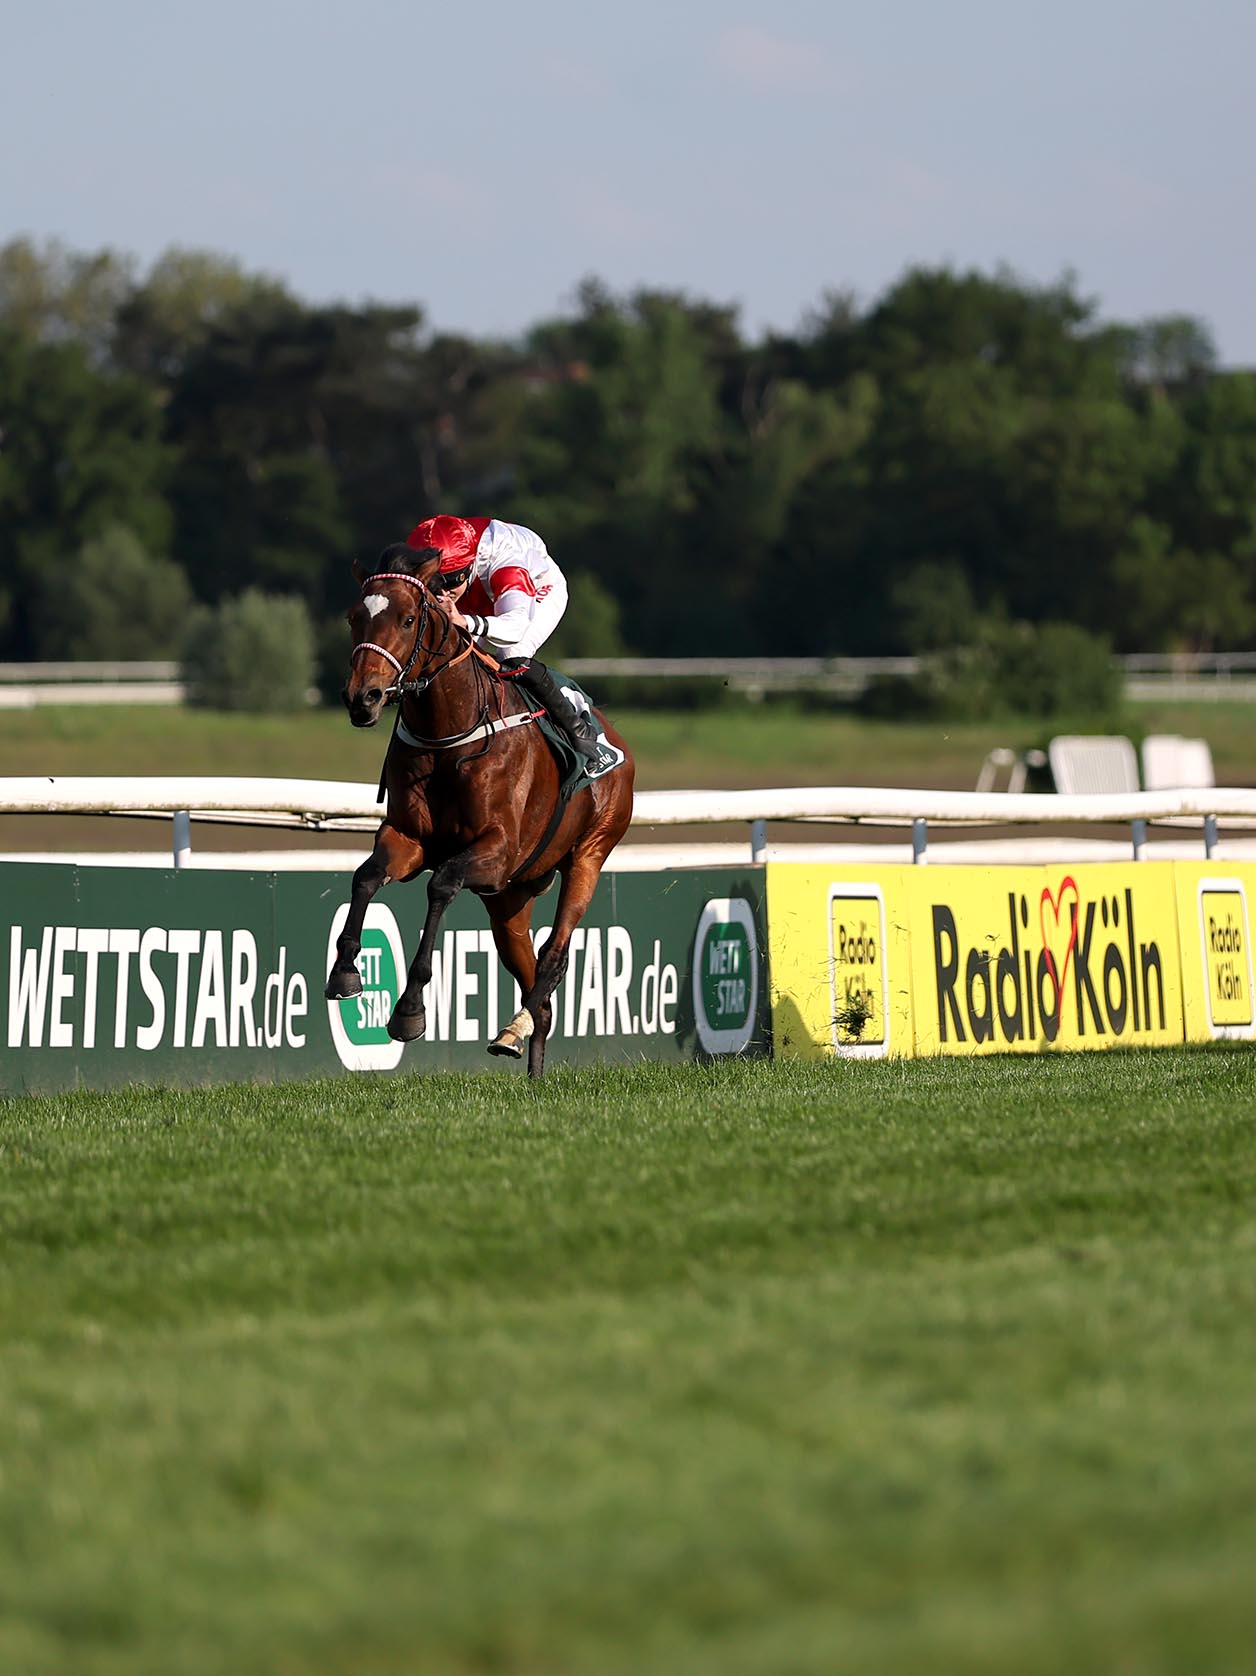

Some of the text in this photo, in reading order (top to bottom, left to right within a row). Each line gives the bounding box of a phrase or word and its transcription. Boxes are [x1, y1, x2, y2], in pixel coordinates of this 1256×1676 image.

[839, 921, 875, 965] Radio
[1210, 913, 1241, 953] Radio
[354, 948, 382, 985] ETT
[710, 939, 741, 975] WETT
[932, 888, 1166, 1044] Radio Köln
[8, 925, 308, 1050] WETTSTAR.de
[717, 979, 745, 1015] STAR
[1217, 960, 1242, 1001] Köln
[357, 990, 392, 1029] STAR
